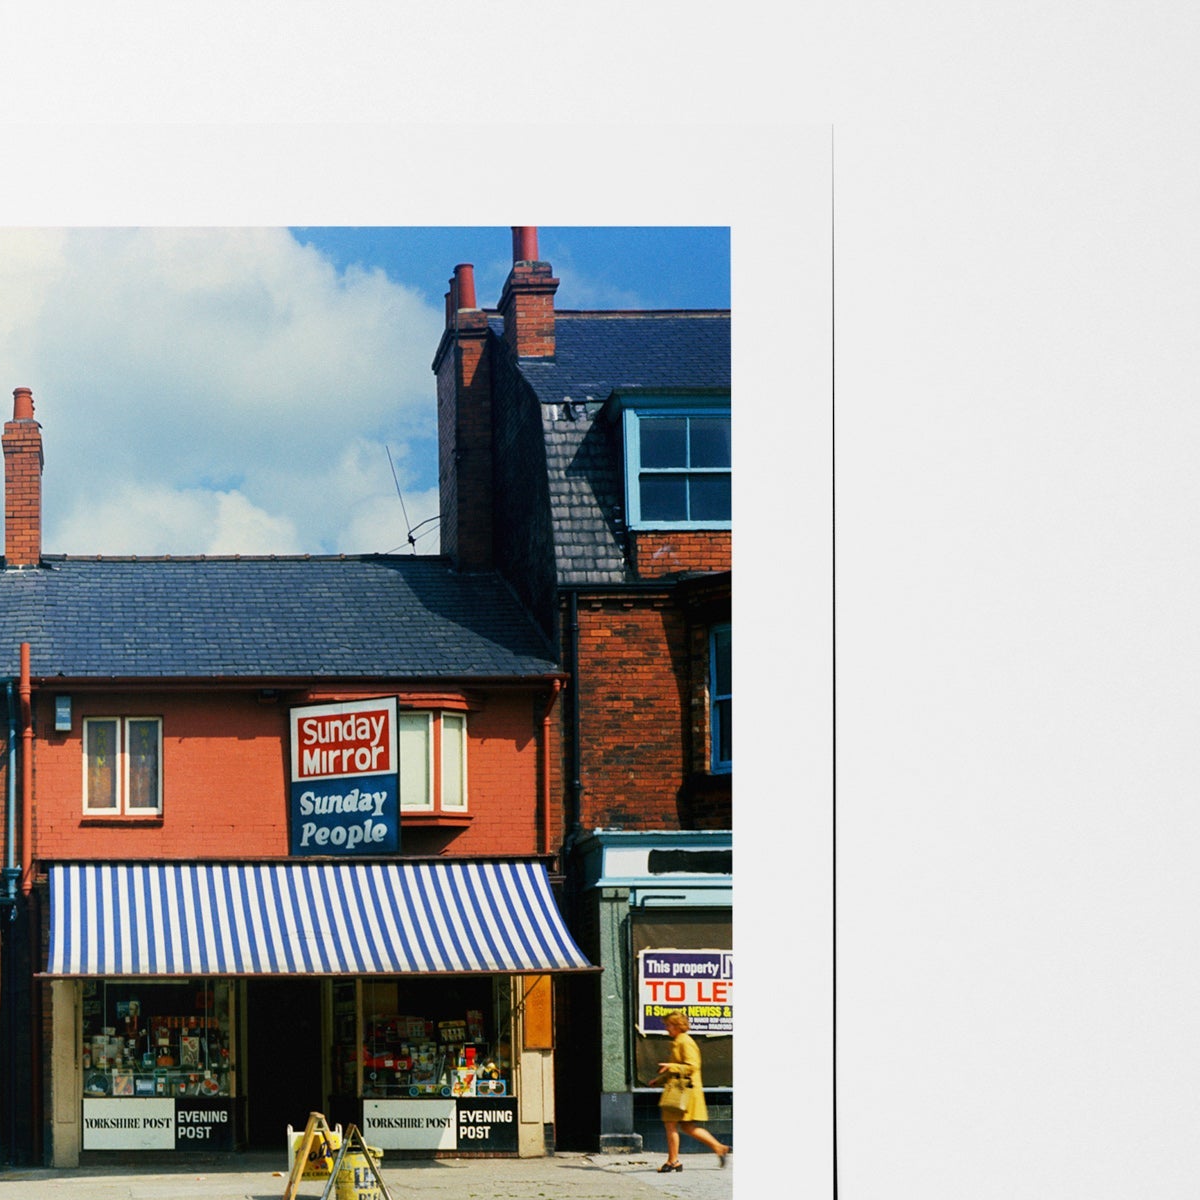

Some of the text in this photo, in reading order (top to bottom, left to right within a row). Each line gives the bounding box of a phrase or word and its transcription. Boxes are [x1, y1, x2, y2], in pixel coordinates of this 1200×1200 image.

[303, 715, 386, 747] Sunday
[303, 746, 384, 775] Mirror
[300, 789, 387, 817] Sunday
[300, 819, 388, 849] People
[646, 959, 670, 974] This
[673, 961, 719, 976] property
[645, 981, 685, 1002] TO
[723, 1006, 731, 1017] &
[178, 1110, 228, 1123] EVENING
[366, 1117, 453, 1129] YORKSHIRE POST
[459, 1110, 513, 1123] EVENING
[85, 1118, 172, 1129] YORKSHIRE POST
[178, 1126, 212, 1139] POST
[459, 1126, 491, 1139] POST
